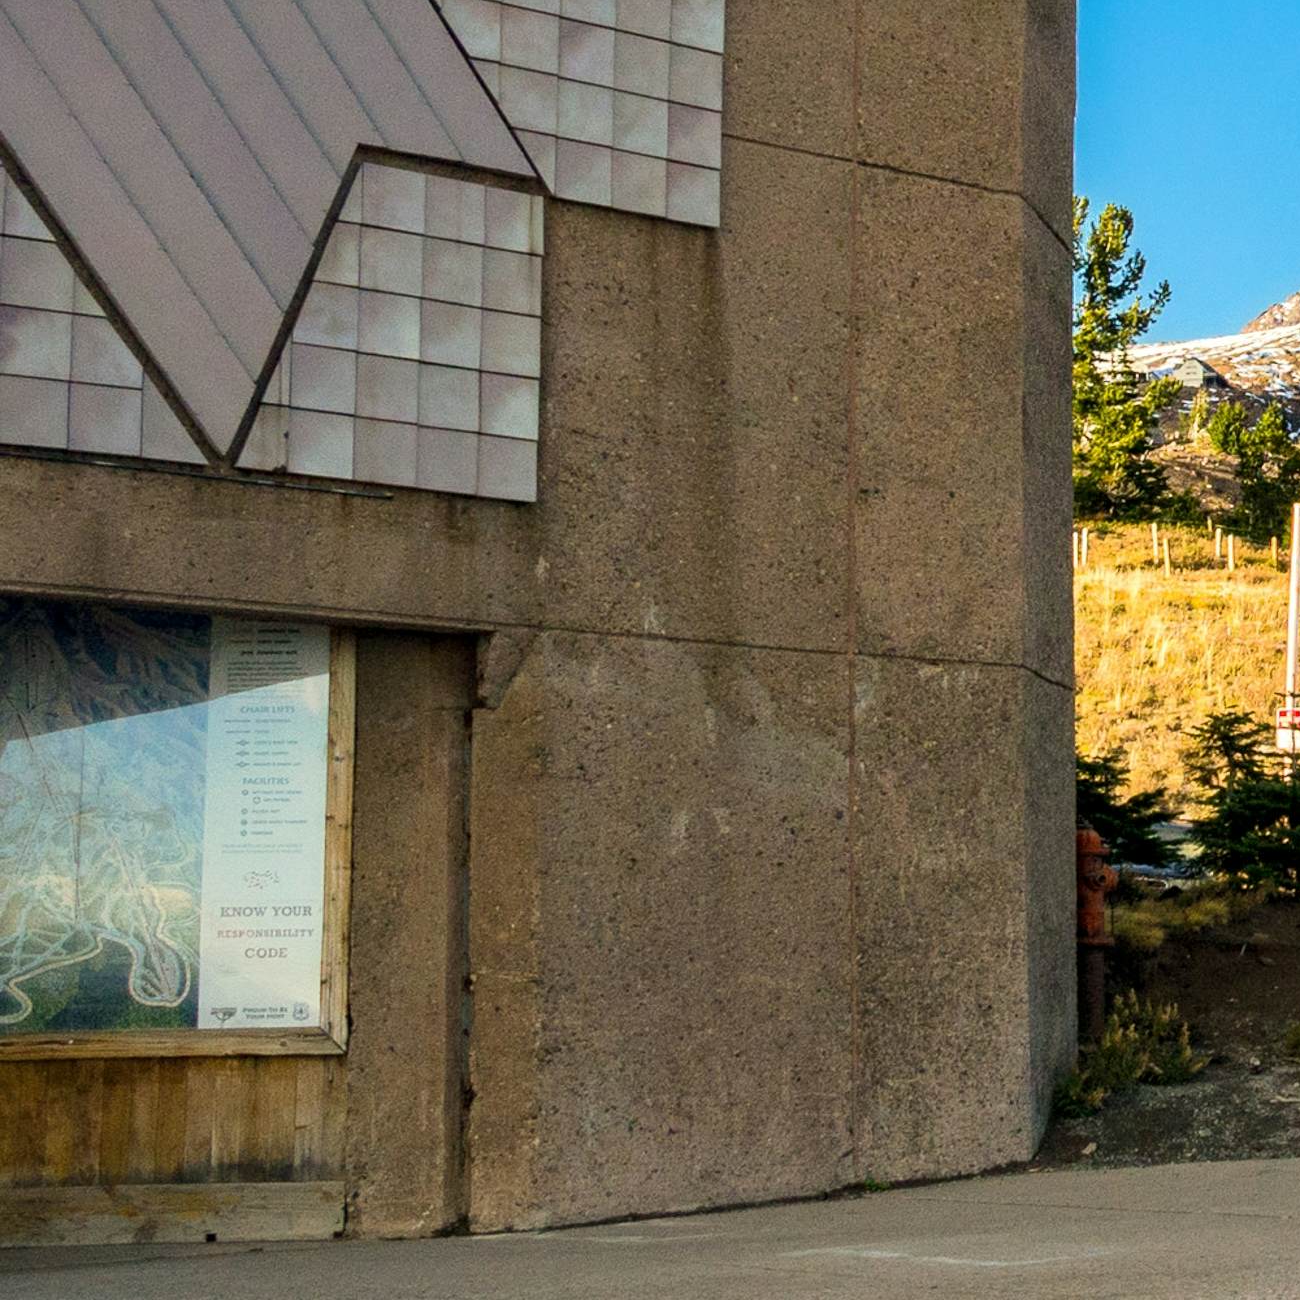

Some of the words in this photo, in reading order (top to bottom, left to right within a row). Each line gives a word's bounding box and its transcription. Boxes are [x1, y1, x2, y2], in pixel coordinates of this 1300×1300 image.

[242, 777, 290, 785] FACILITIES
[220, 906, 267, 917] KNOW
[271, 905, 313, 916] YOUR
[217, 928, 314, 939] RESPONSIBILITY
[244, 947, 288, 959] CODE
